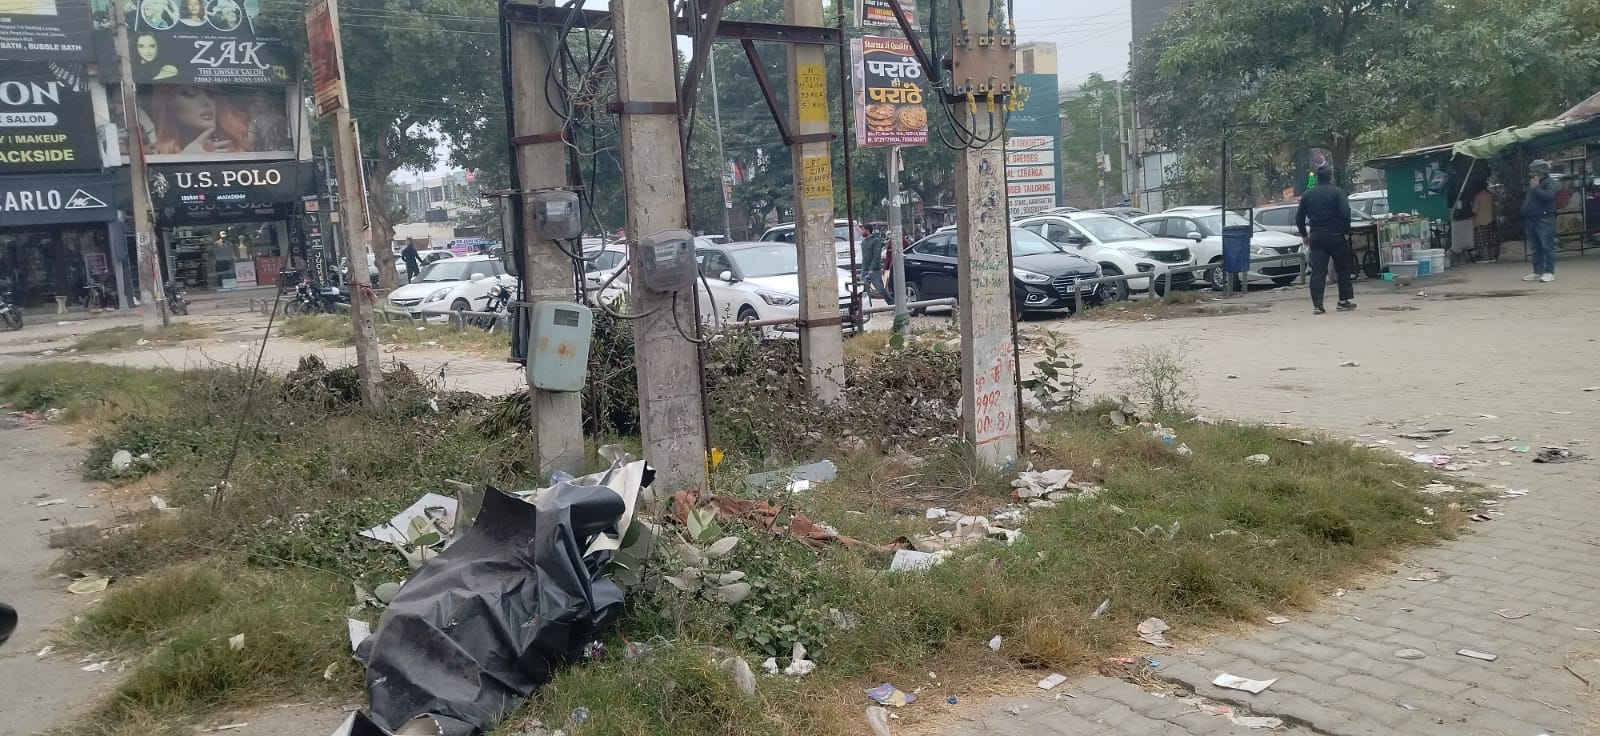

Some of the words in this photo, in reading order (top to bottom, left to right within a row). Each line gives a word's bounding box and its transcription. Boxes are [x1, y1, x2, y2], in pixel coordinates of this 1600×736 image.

[190, 40, 270, 69] ZAK
[6, 115, 46, 124] SALON
[15, 134, 67, 144] MAKEUP
[1012, 153, 1039, 163] DRESSES
[176, 171, 219, 188] U.S.
[221, 168, 281, 187] POLO
[1024, 183, 1051, 193] TAILORING
[0, 189, 61, 212] ARLO
